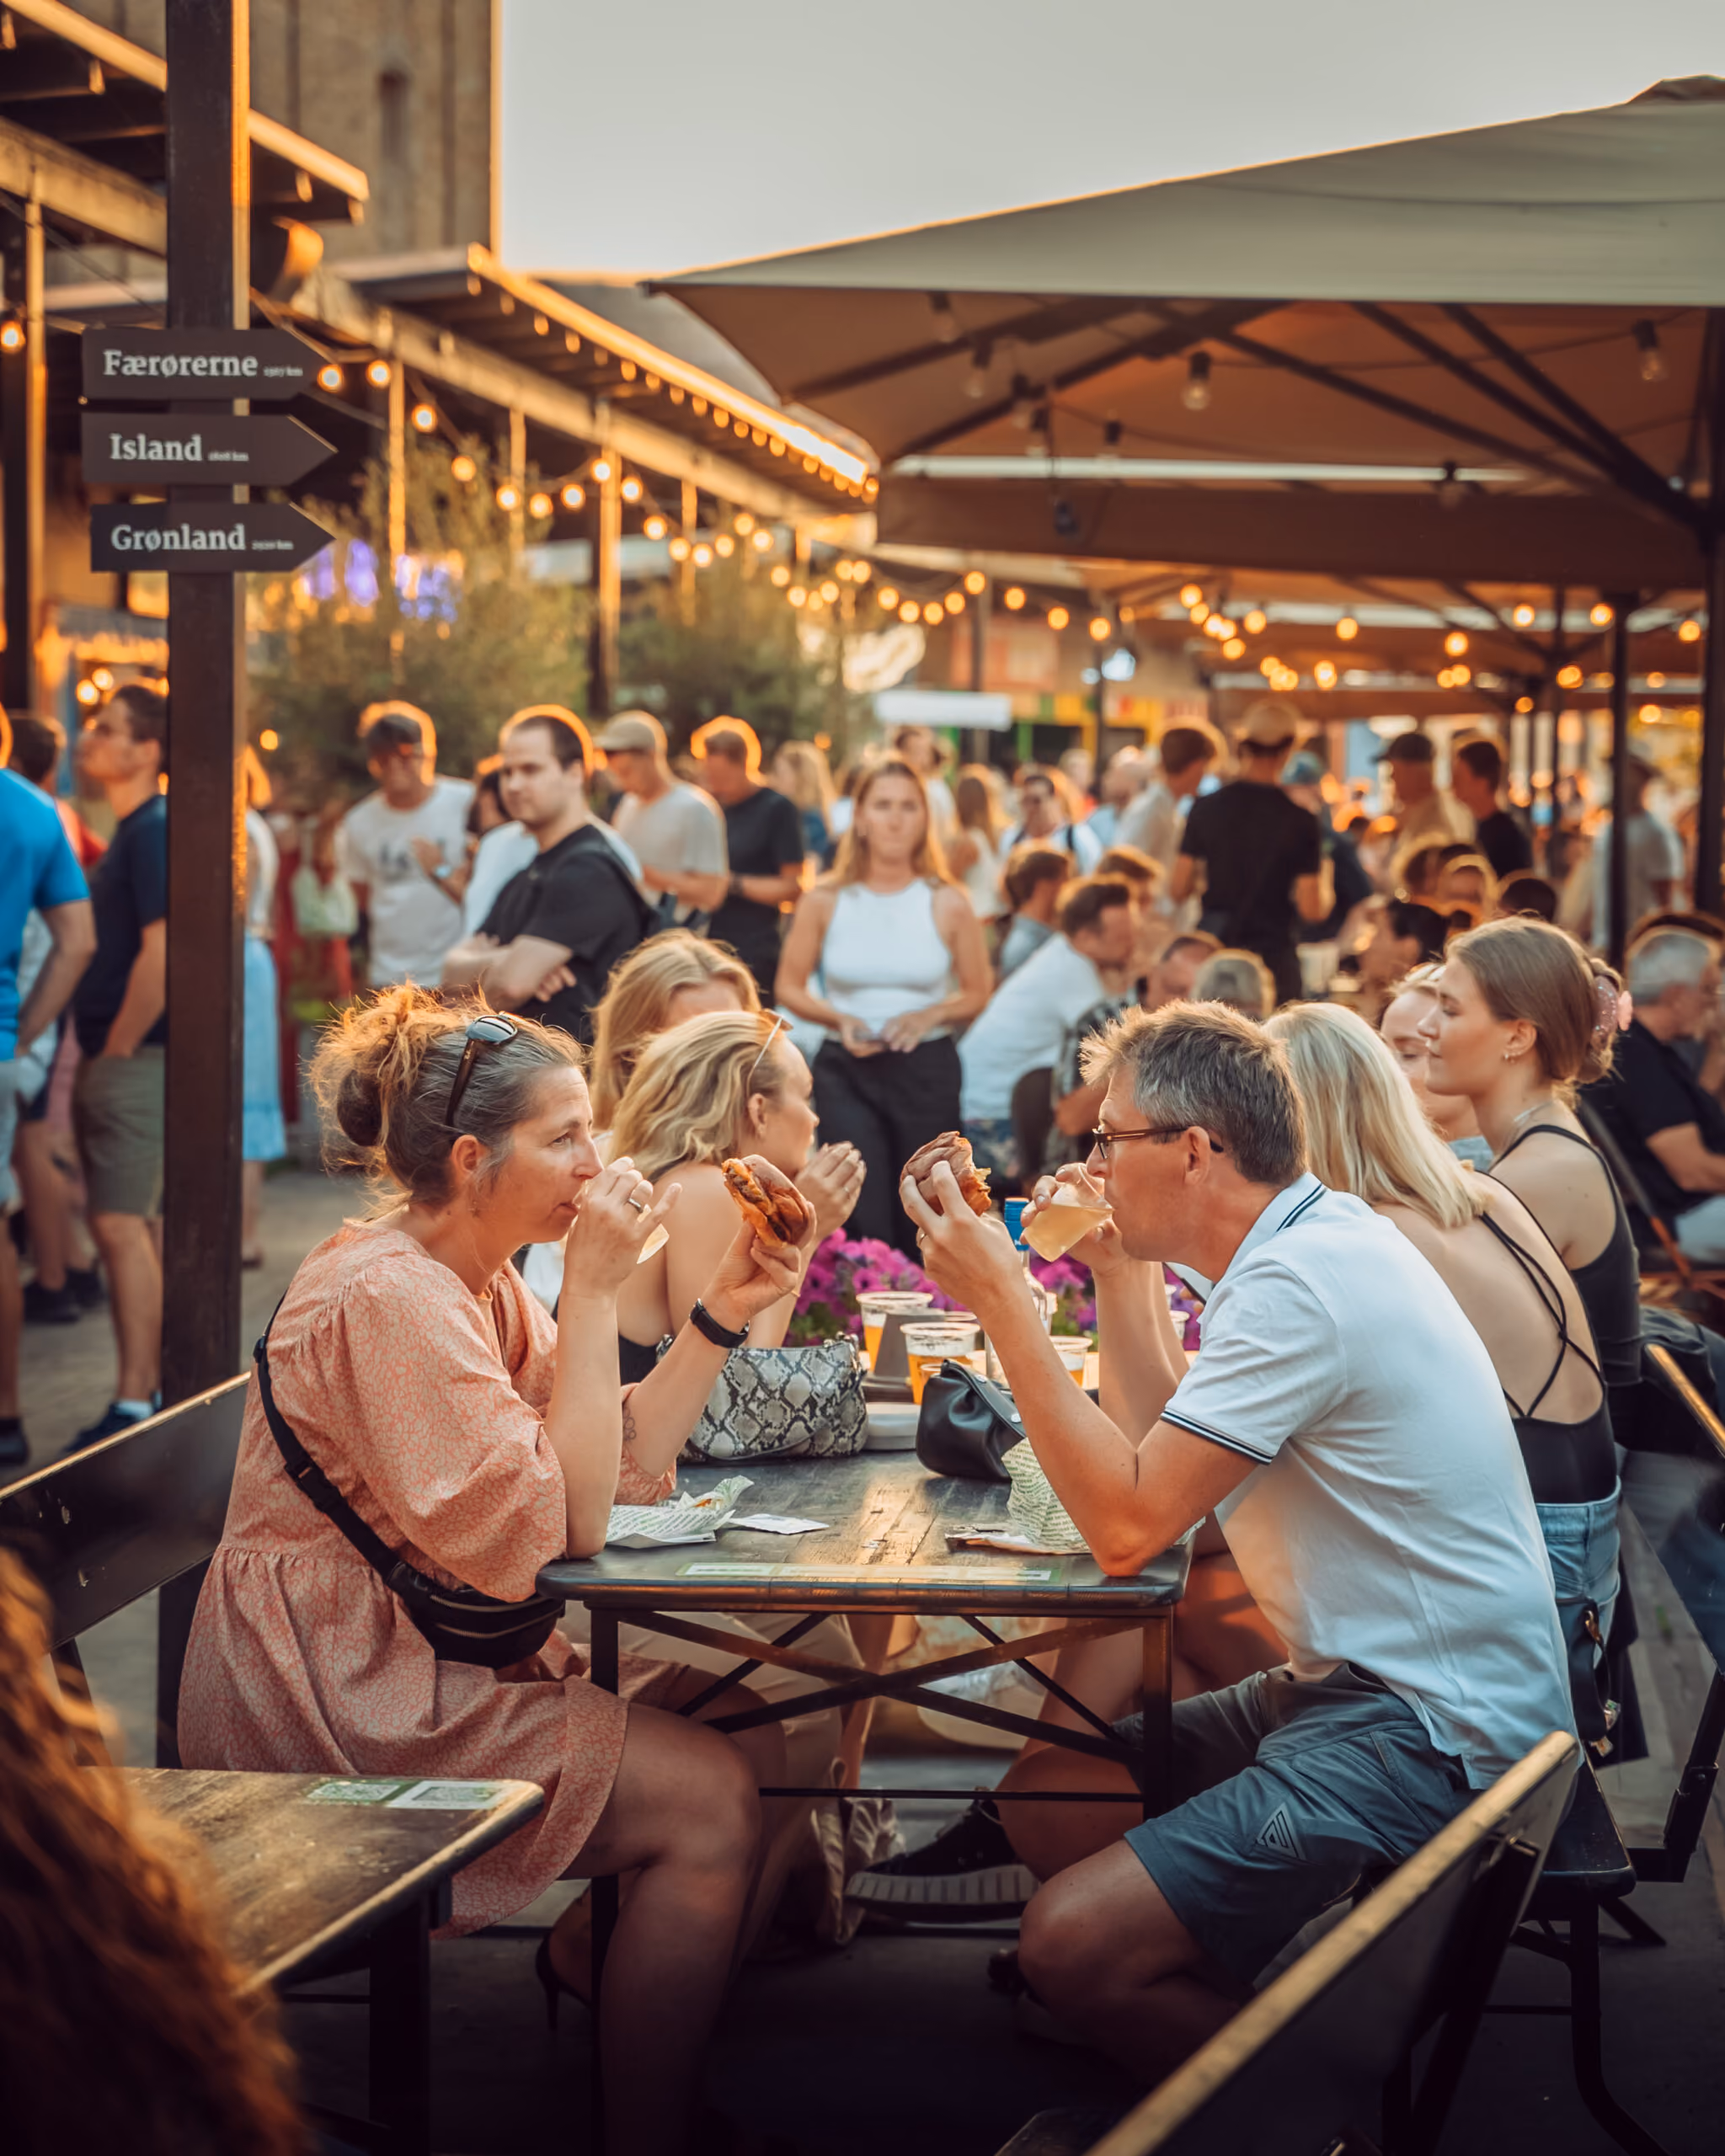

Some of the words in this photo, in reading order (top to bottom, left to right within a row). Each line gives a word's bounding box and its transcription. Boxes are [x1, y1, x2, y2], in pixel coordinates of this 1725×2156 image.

[103, 349, 259, 377] Færørerne
[109, 433, 203, 461] Island
[111, 523, 246, 551] Grønland
